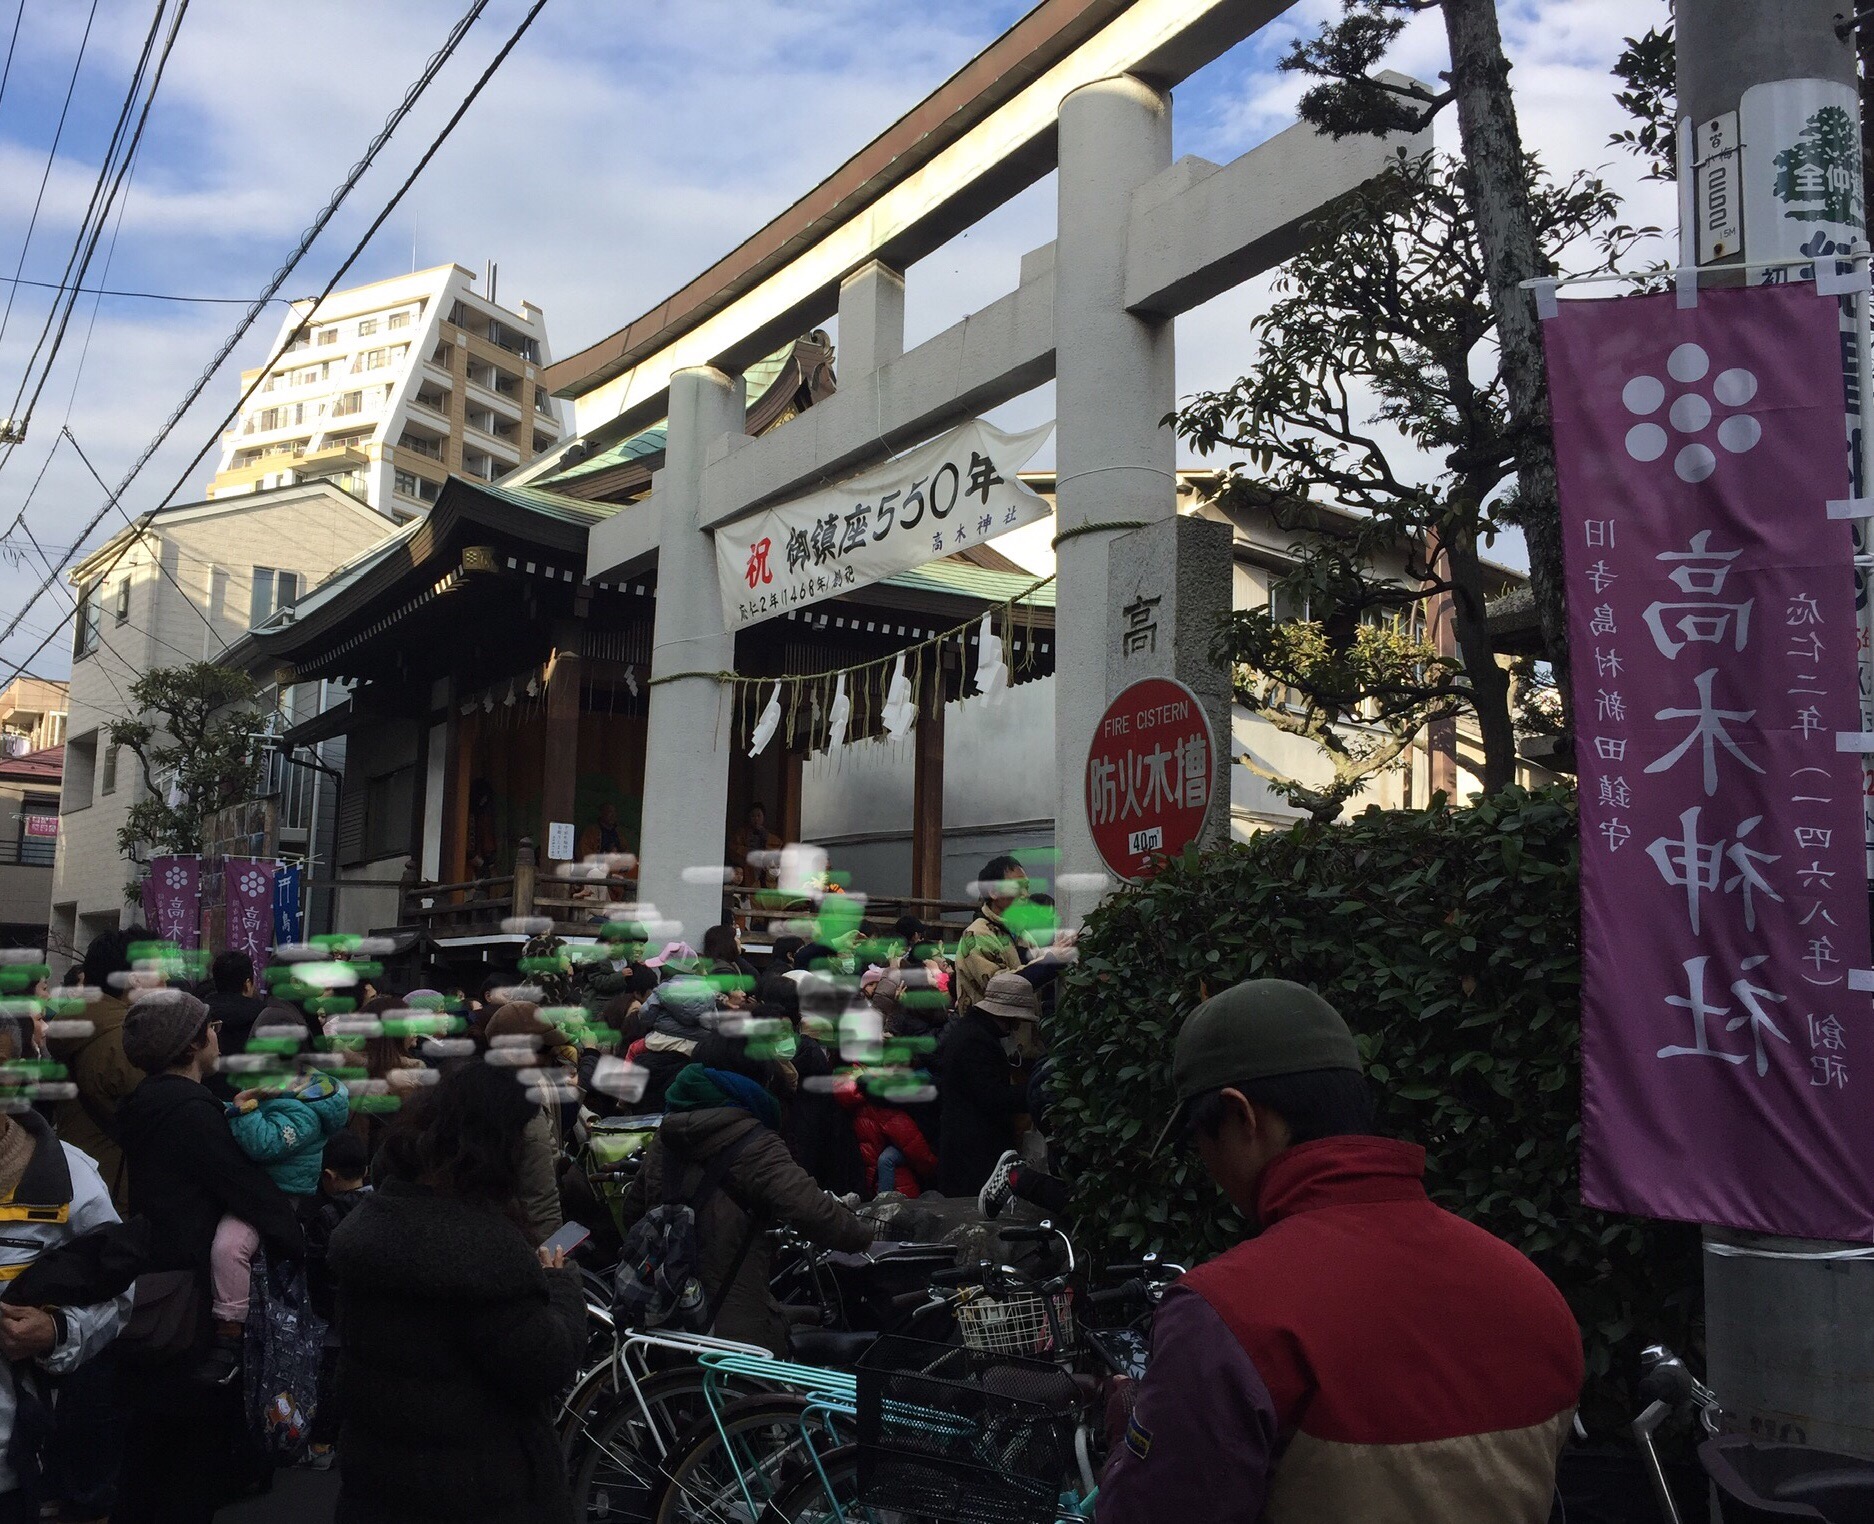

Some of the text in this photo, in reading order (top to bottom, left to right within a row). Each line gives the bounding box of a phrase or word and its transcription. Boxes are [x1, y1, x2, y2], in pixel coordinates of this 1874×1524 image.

[1708, 167, 1727, 230] 262
[932, 505, 1017, 553] 高木神社
[745, 537, 774, 589] 祝
[1122, 594, 1162, 656] 高
[1104, 700, 1189, 738] FIRE CISTERN
